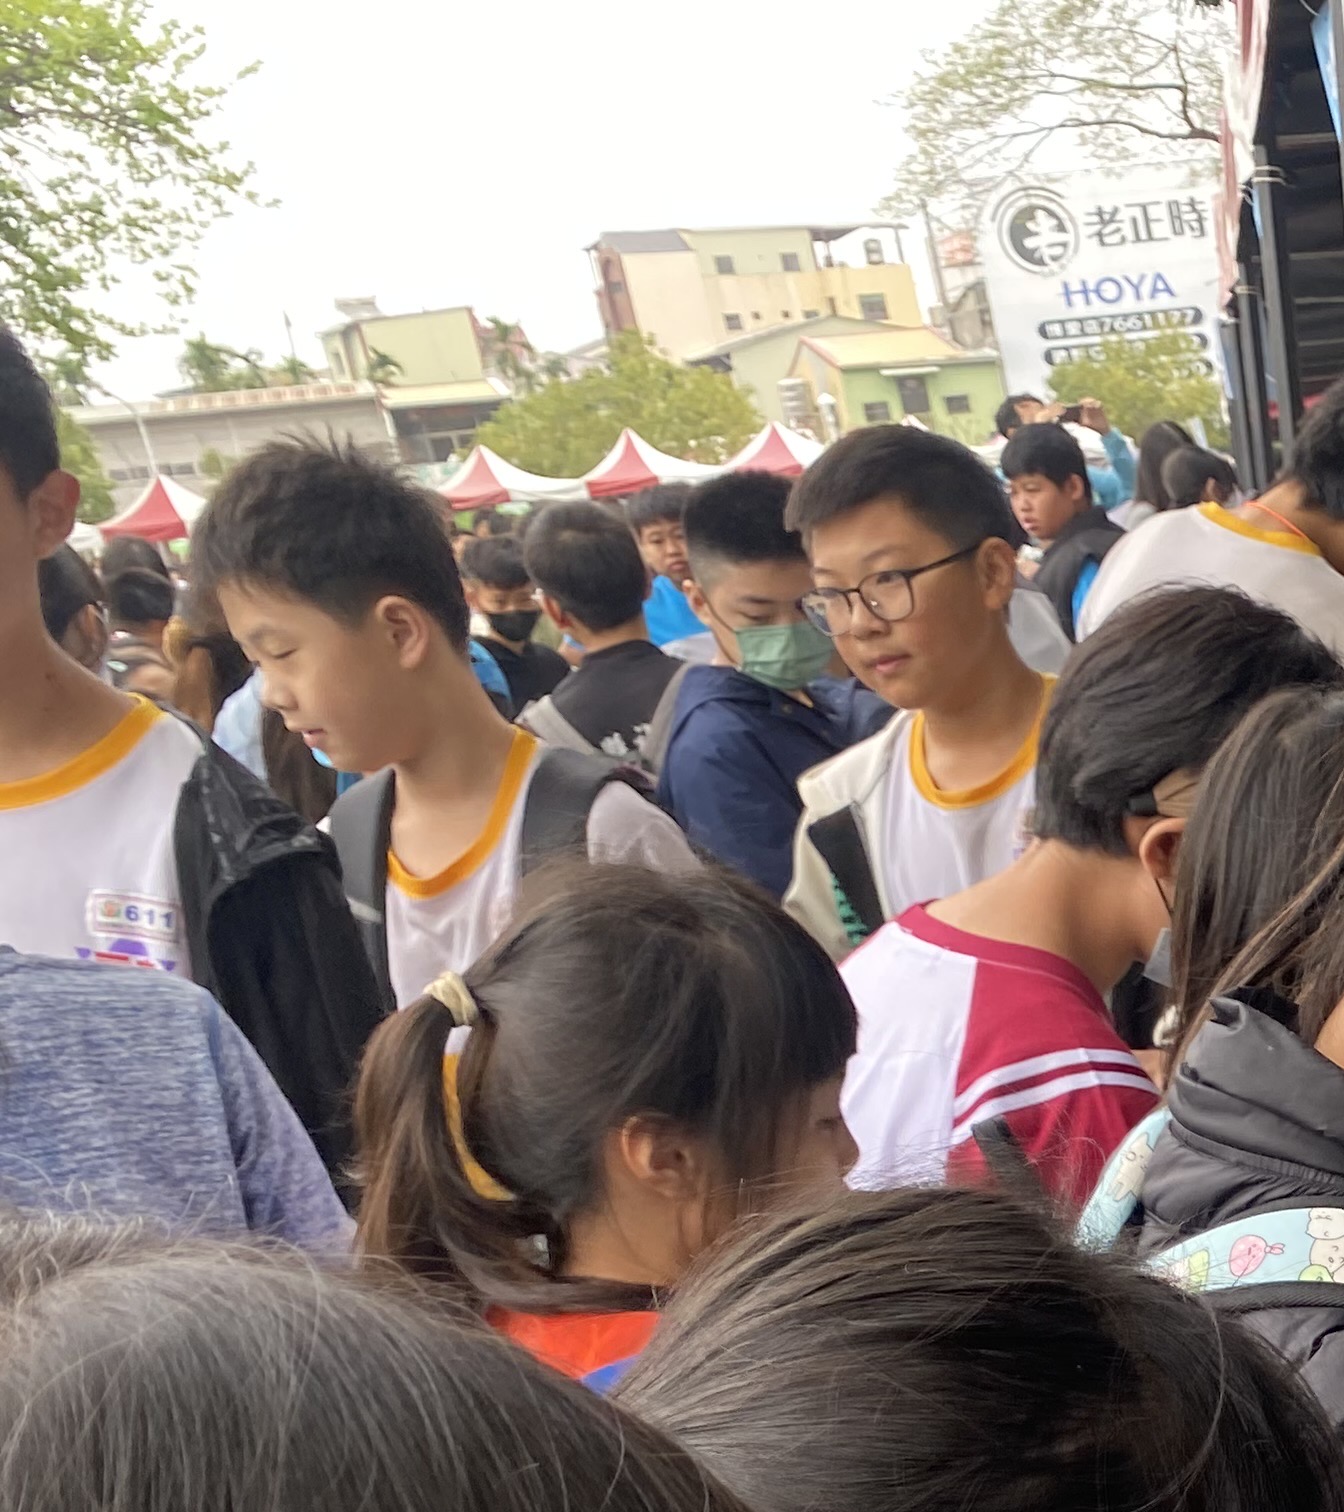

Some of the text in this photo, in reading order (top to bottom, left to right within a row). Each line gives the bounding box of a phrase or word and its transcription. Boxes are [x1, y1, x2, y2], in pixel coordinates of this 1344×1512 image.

[1083, 196, 1208, 247] 老正時
[1061, 272, 1176, 307] HOYA
[126, 905, 172, 928] 611
